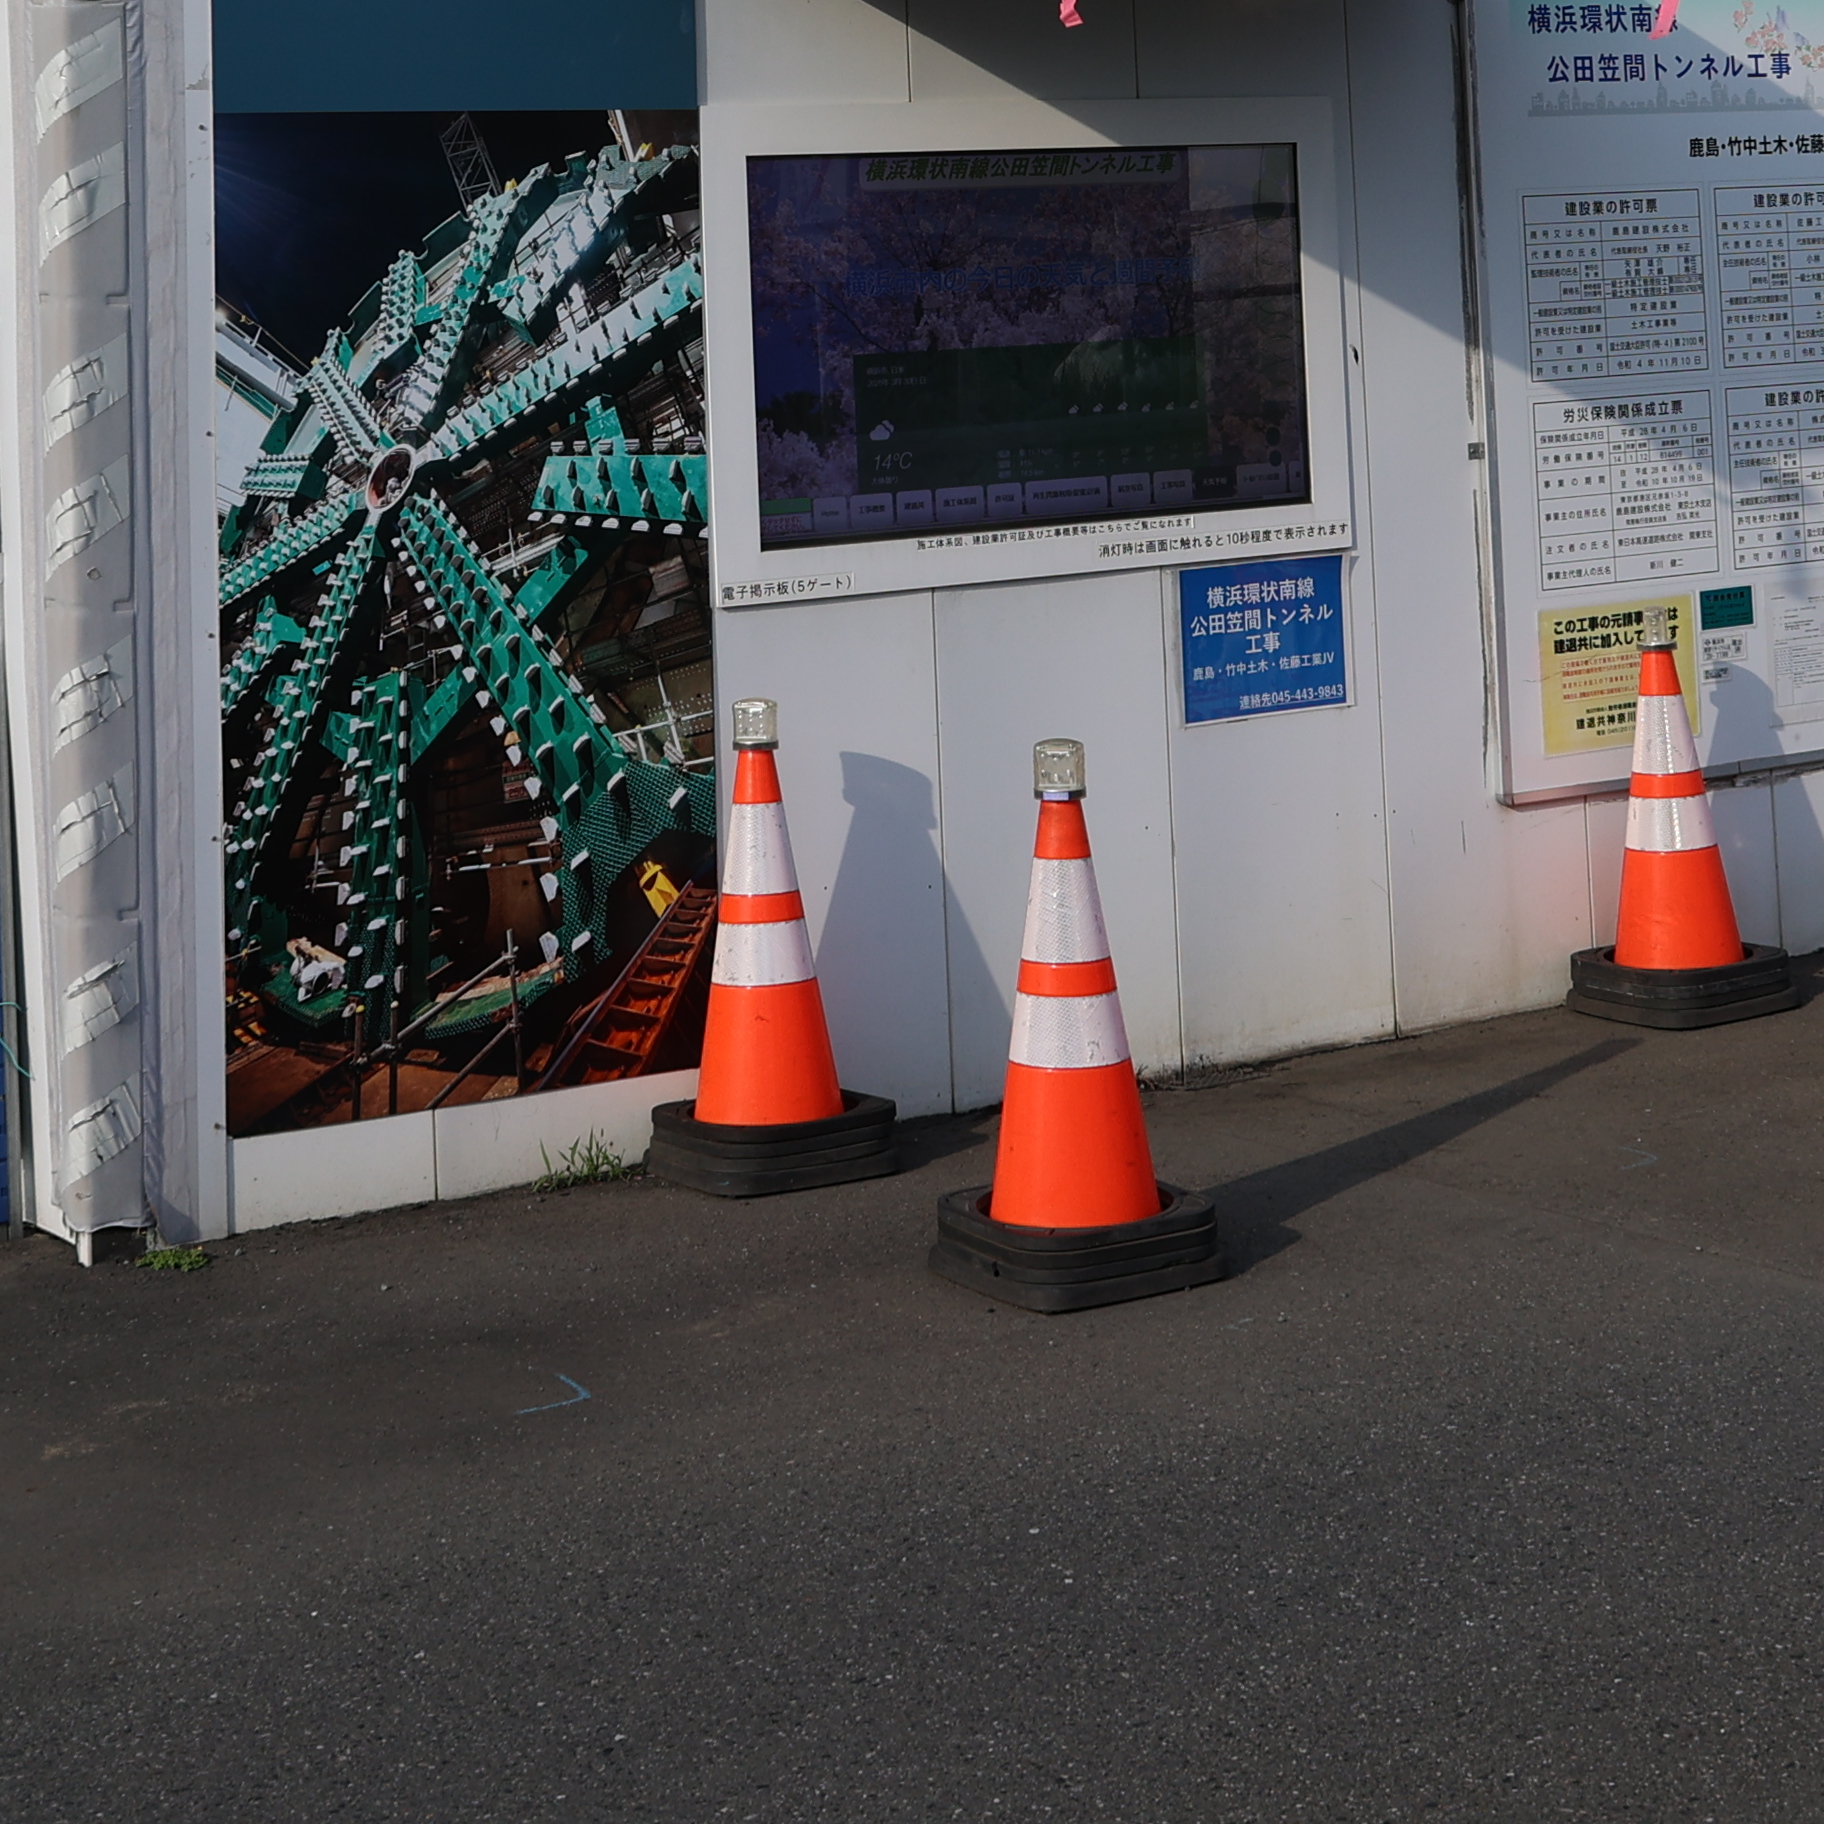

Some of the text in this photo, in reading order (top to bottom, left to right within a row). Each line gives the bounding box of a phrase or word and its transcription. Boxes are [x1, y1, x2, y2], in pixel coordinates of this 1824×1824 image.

[1546, 51, 1792, 83] 公田笠間トンネル工事
[865, 151, 1177, 183] 横浜環状南線公田笠間トンネル工事
[1565, 198, 1658, 217] 建設業の許可票
[1535, 324, 1602, 337] 許可を受けた建設業
[1563, 399, 1683, 424] 労災保険関係成立票
[1540, 430, 1604, 444] 保険関係成立年月日
[1545, 507, 1607, 522] 事業主の住所氏名
[1737, 511, 1800, 525] 許可を受けた建設業
[916, 517, 1191, 551] 施工体系図、建設業許可証及び工事概要等はこちらでご覧になれます
[1099, 522, 1348, 558] 消灯時は画面に触れると10秒程度で表示されます
[722, 575, 852, 601] 電子掲示板(5ゲート)
[1207, 576, 1314, 609] 横浜環状南線
[1190, 603, 1333, 637] 公田笠間トンネル
[1245, 631, 1280, 654] 工事
